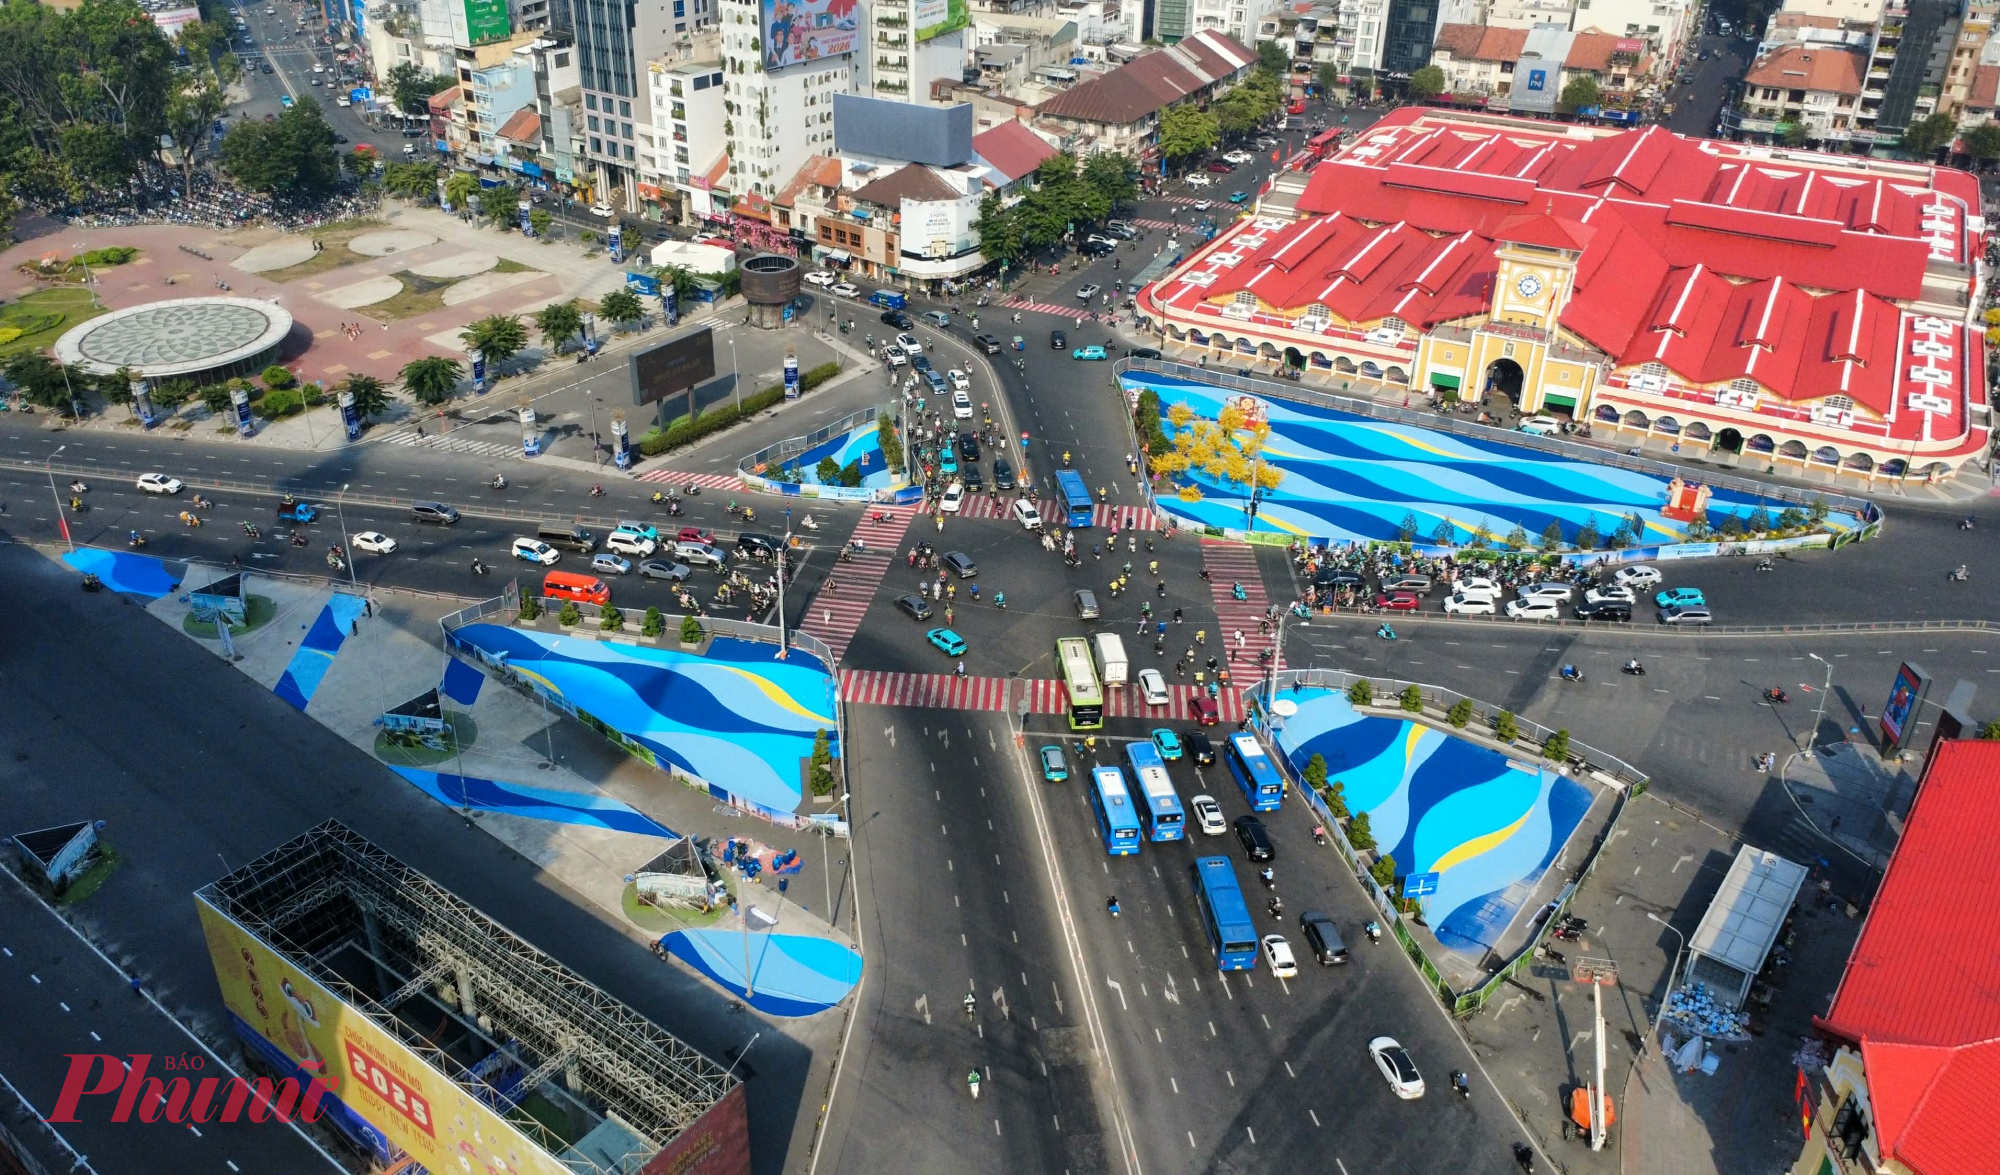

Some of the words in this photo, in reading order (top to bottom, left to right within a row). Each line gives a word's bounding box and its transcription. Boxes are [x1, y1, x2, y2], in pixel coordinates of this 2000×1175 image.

[828, 41, 850, 54] 2026
[345, 1026, 364, 1048] CHÚC
[352, 1052, 428, 1126] 2025
[358, 1086, 386, 1118] HAPPY
[390, 1112, 409, 1134] NEW
[413, 1128, 435, 1153] YEAR
